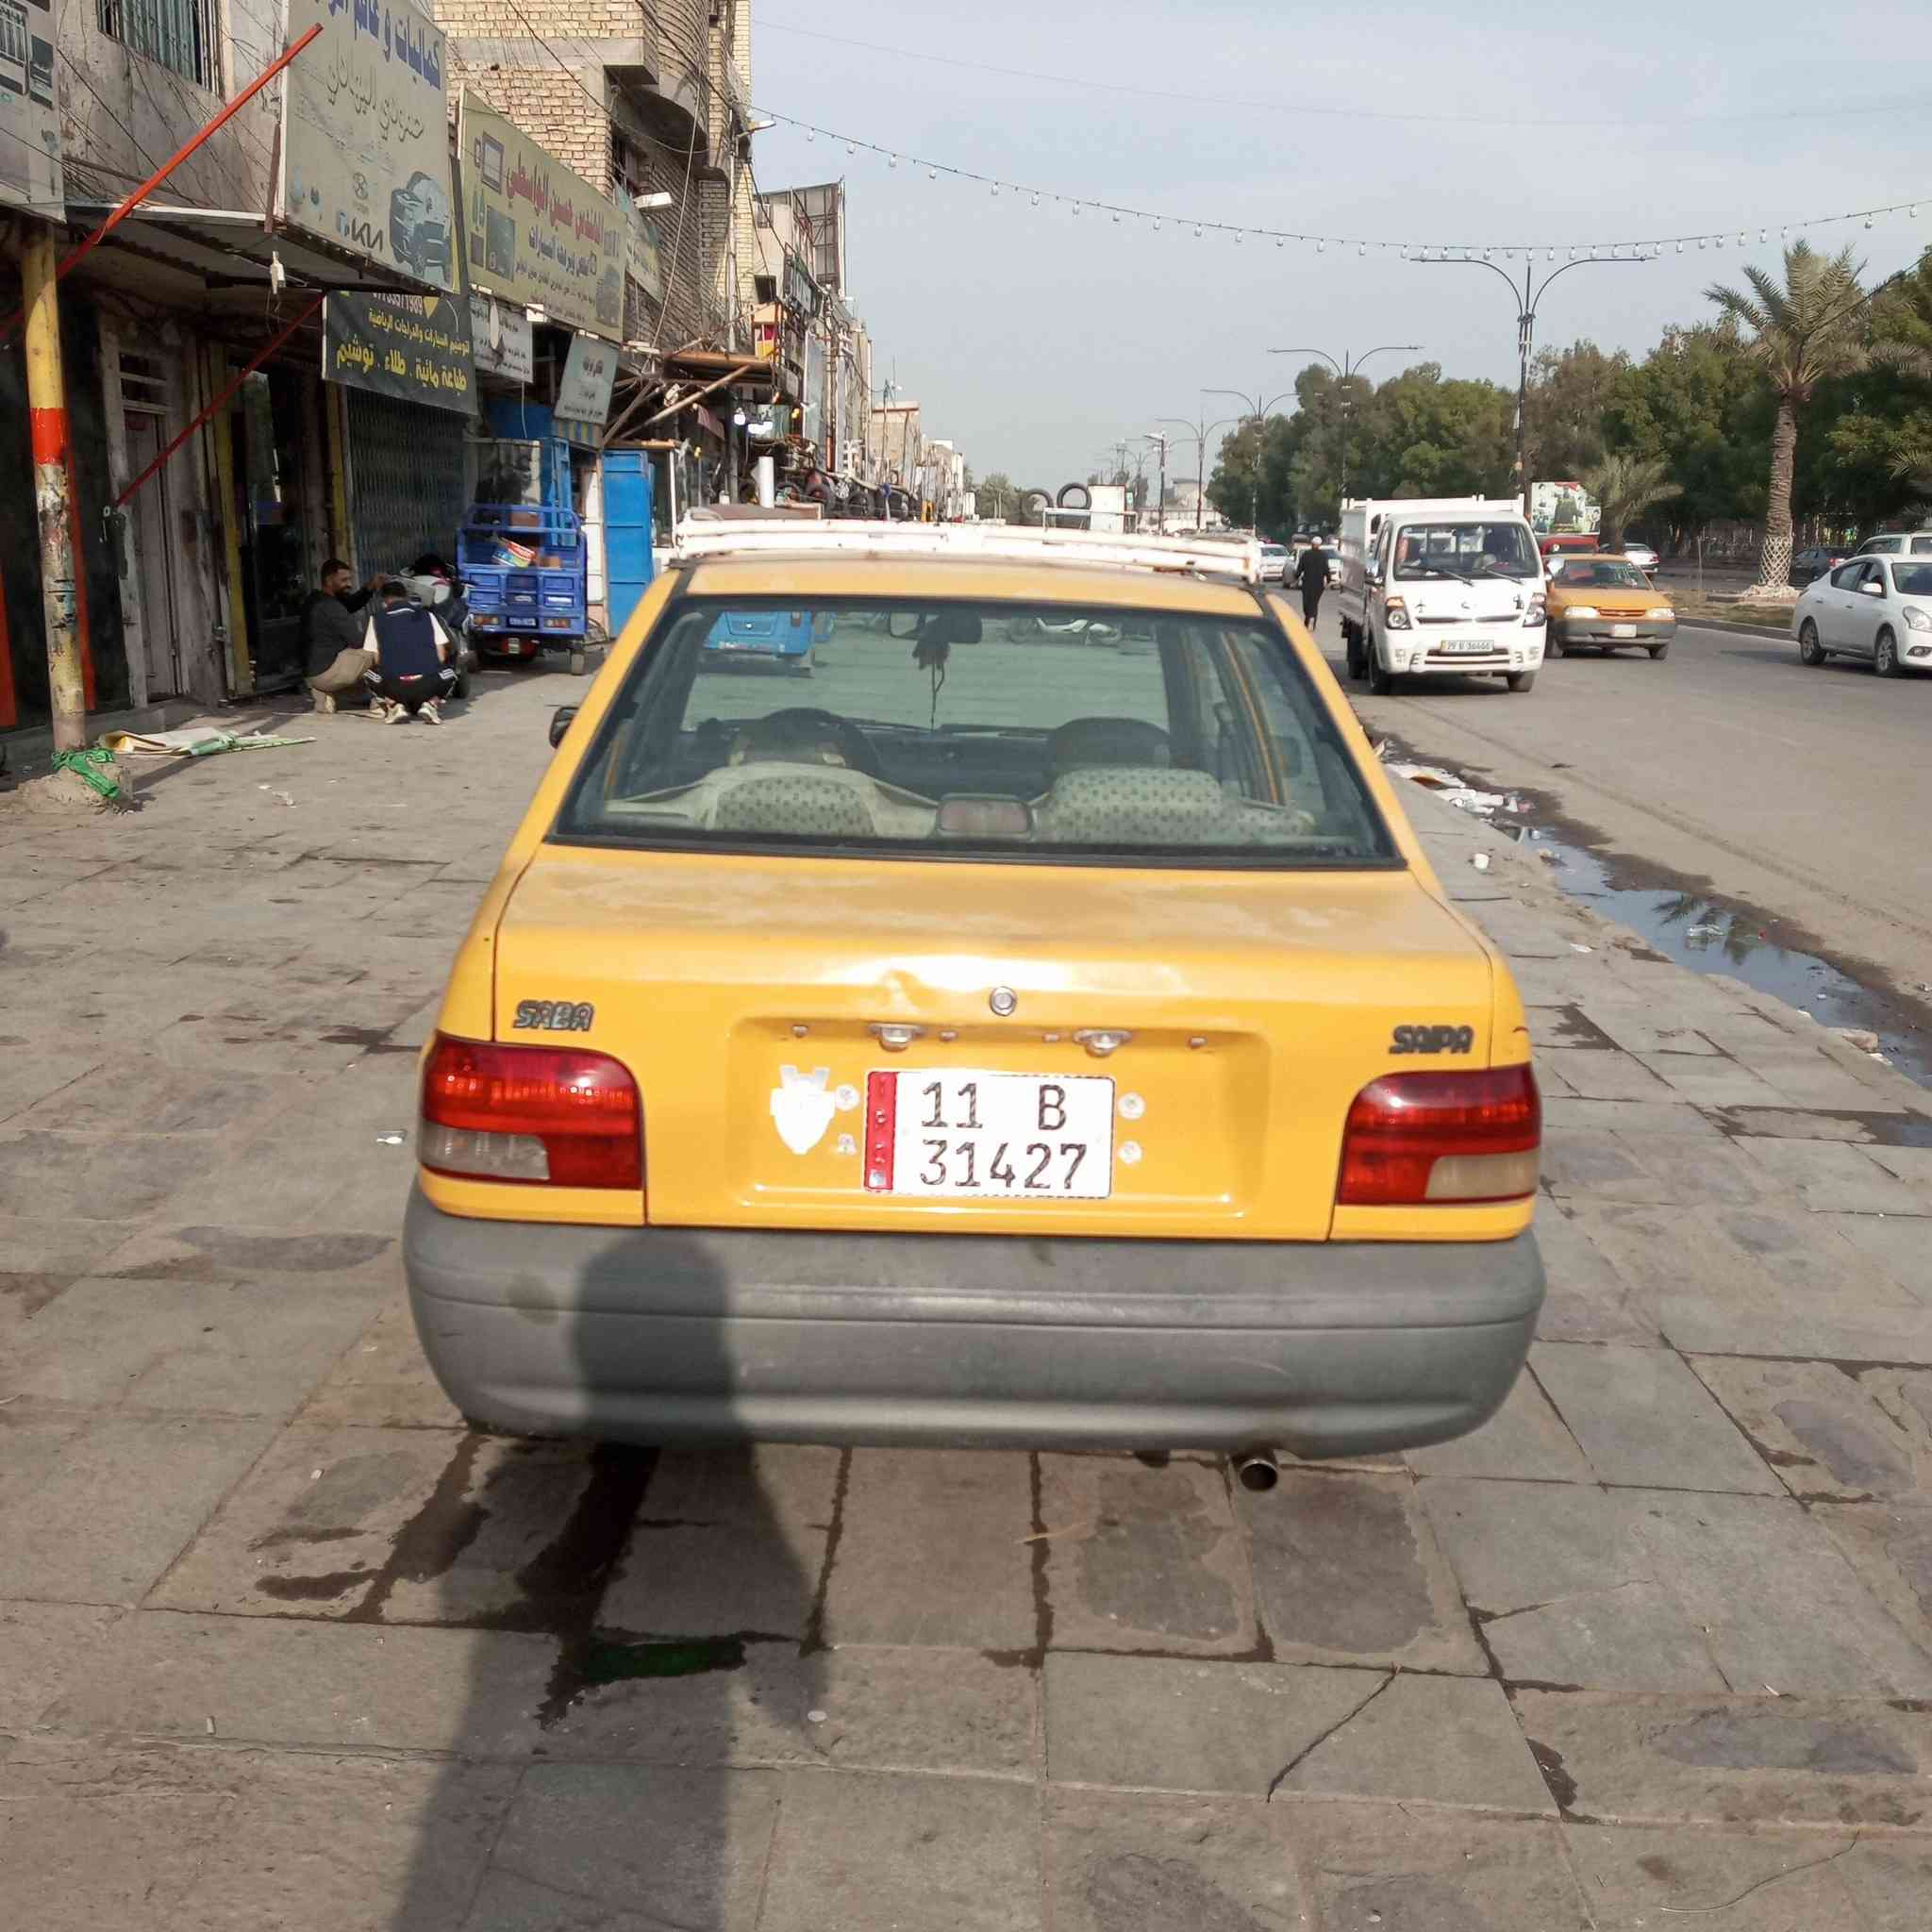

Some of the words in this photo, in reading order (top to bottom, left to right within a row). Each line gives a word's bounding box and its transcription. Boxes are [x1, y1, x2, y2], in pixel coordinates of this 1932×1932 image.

[383, 8, 391, 62] و
[395, 15, 441, 91] كماليات
[336, 334, 375, 374] توشيم
[385, 349, 407, 375] طلاء
[415, 357, 440, 388] مائية
[441, 364, 467, 396] طباعة
[513, 999, 595, 1032] SABA
[1389, 1024, 1474, 1055] SAIPA
[921, 1082, 984, 1130] 11
[1038, 1084, 1067, 1130] B
[919, 1139, 1088, 1190] 31427
